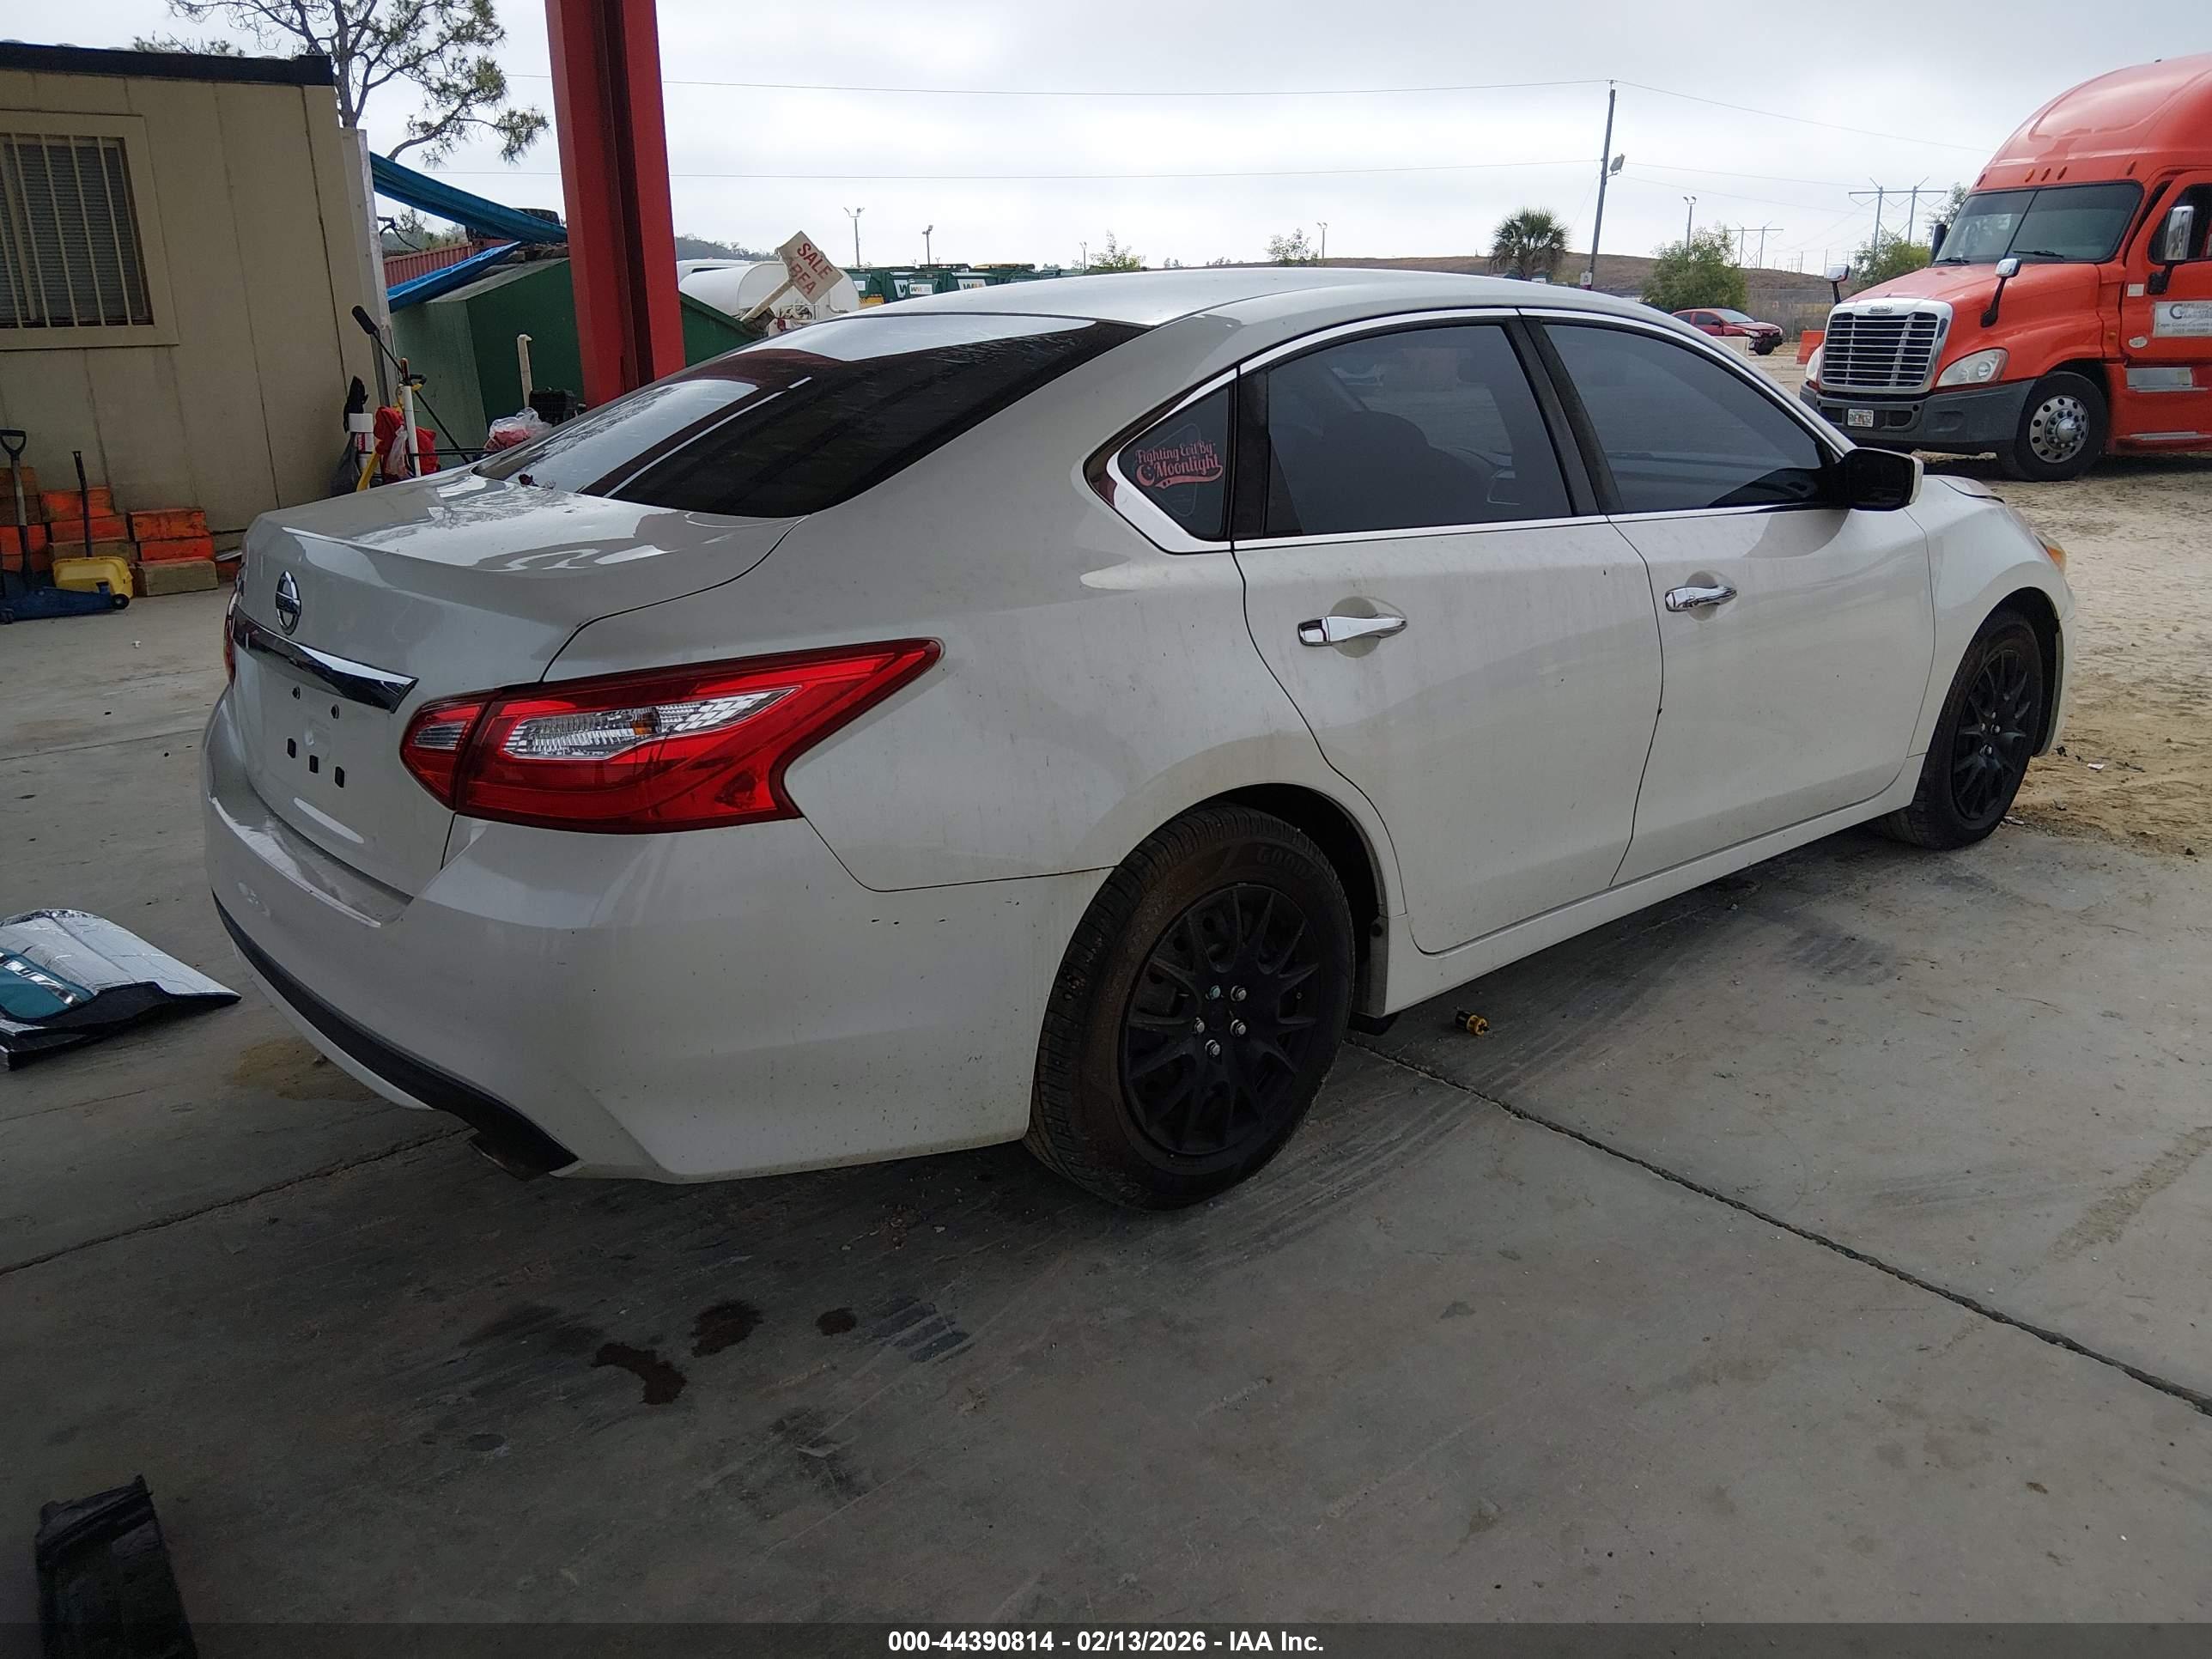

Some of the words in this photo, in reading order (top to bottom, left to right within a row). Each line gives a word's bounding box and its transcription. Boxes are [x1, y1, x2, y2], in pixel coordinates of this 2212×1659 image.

[797, 242, 833, 280] SALE
[1135, 447, 1179, 465] Fighting
[1180, 442, 1197, 457] Evil
[1196, 440, 1212, 457] By
[1154, 453, 1219, 477] Moonlight
